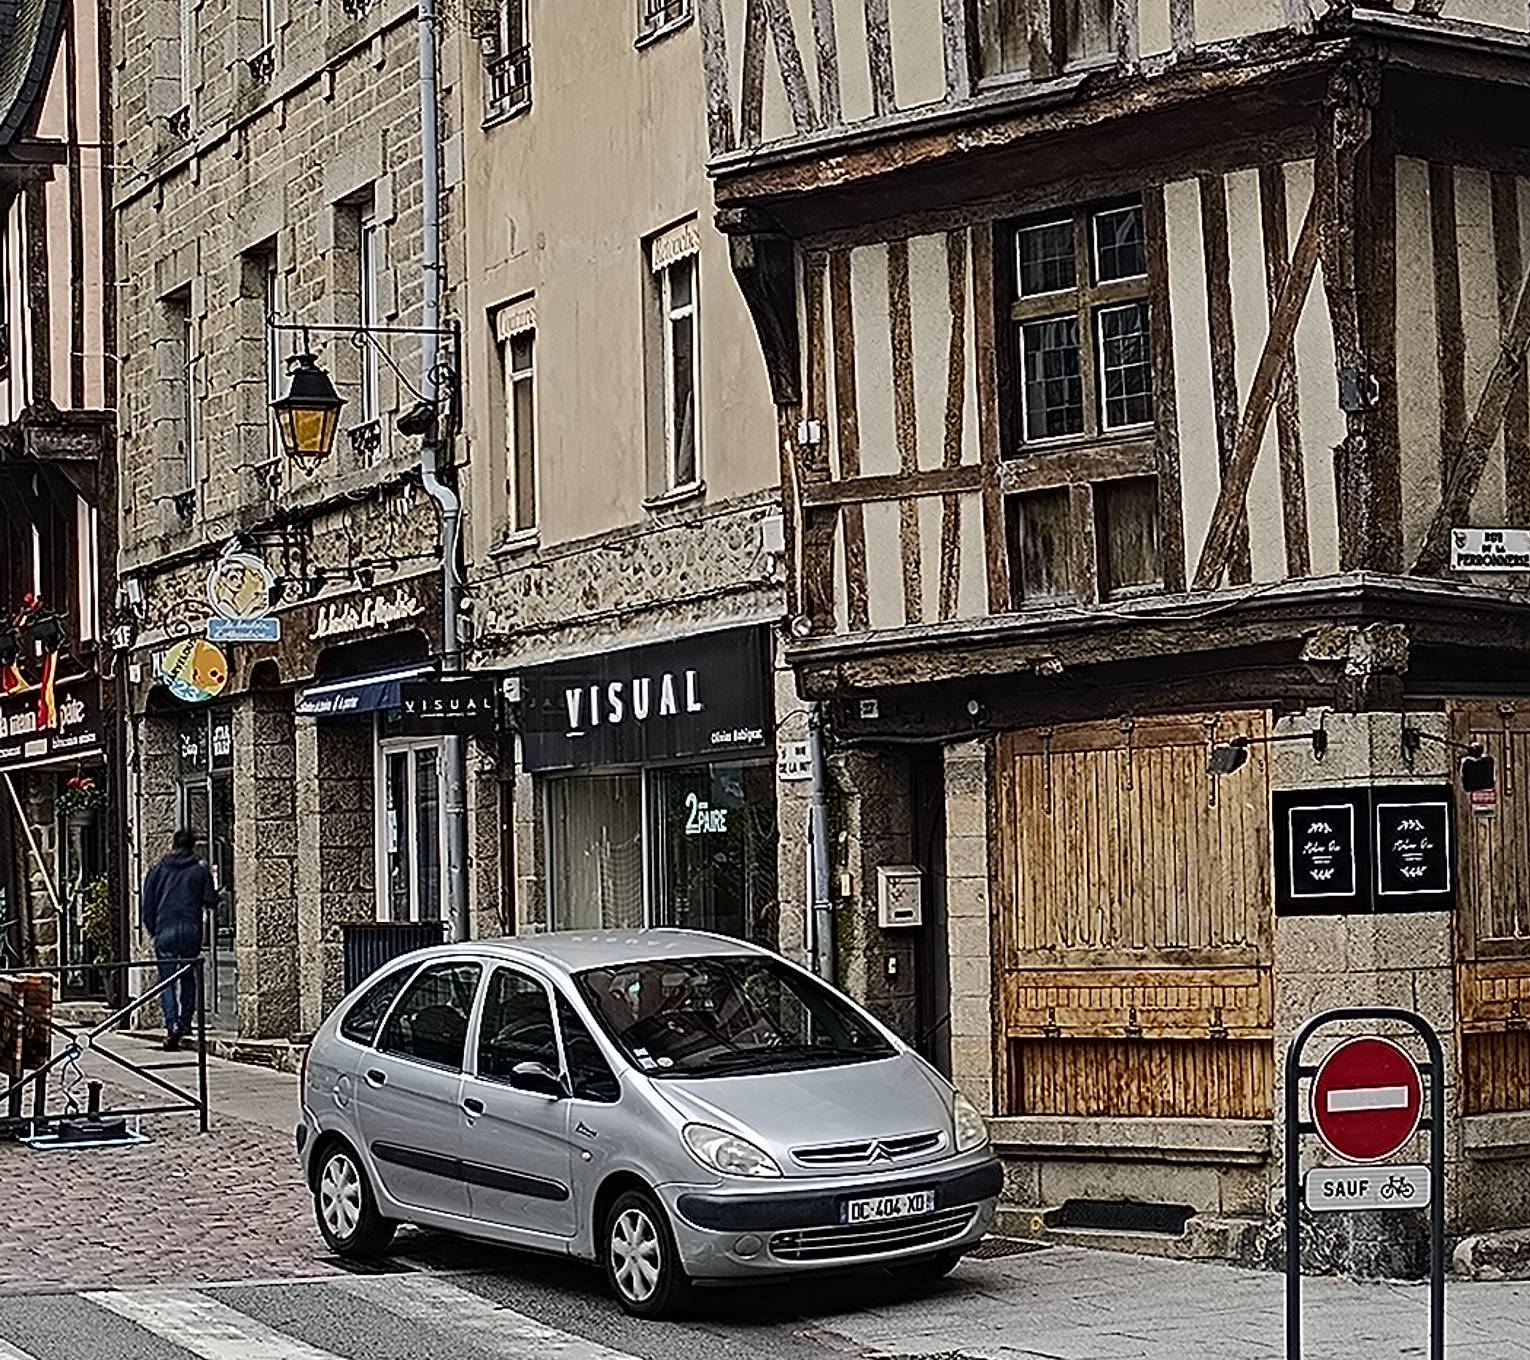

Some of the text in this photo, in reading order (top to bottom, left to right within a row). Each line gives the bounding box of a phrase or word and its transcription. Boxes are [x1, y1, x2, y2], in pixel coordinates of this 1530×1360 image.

[405, 698, 491, 713] VISUAL
[565, 670, 702, 729] VISUAL
[698, 808, 728, 834] PAIRE
[1323, 1180, 1370, 1197] SAUF
[851, 1194, 925, 1220] DC-404-XD
